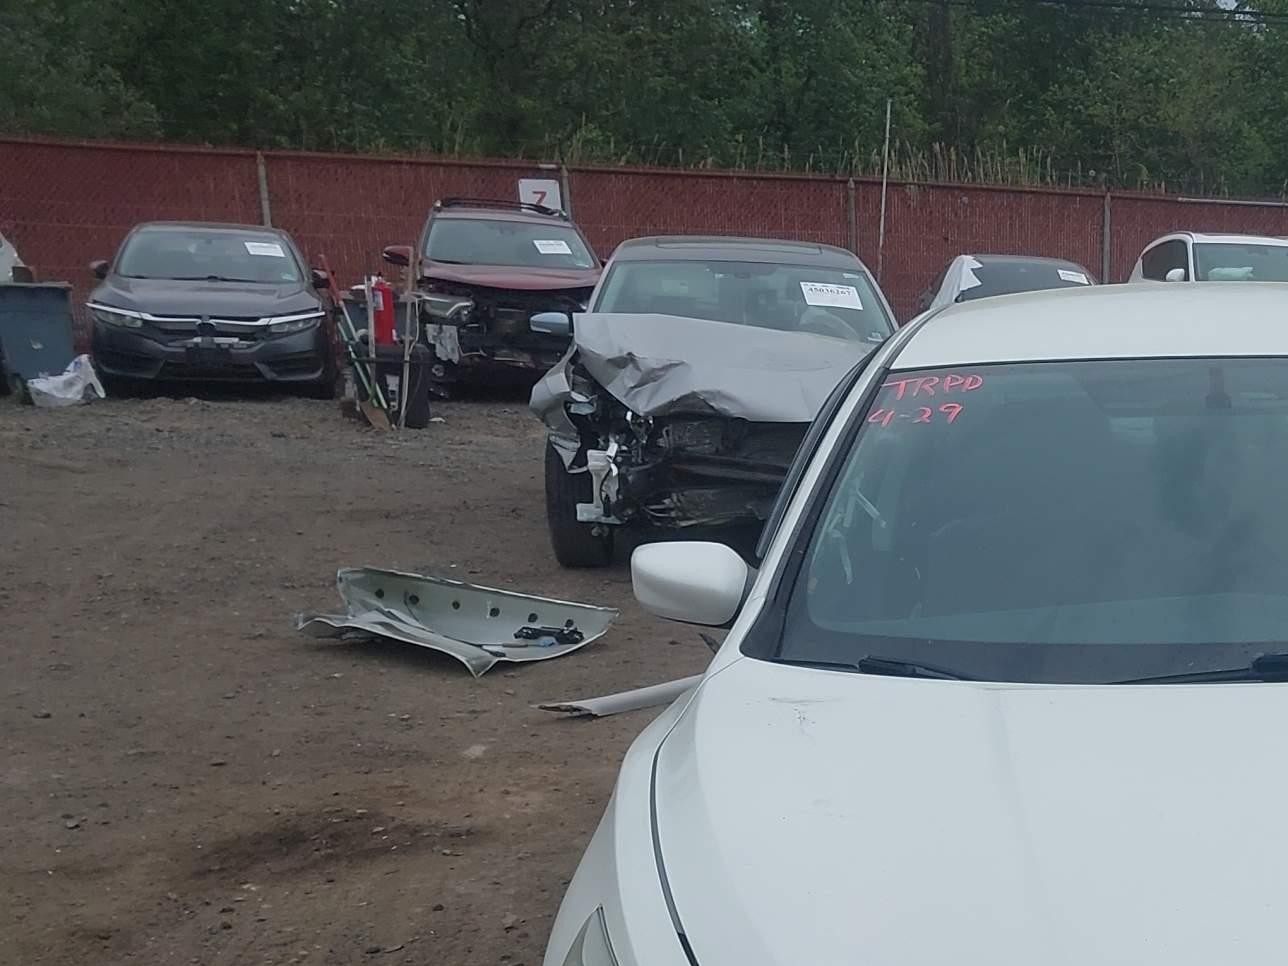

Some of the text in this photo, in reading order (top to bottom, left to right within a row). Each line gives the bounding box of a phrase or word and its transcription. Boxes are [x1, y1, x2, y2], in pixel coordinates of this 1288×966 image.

[532, 190, 548, 206] 7
[881, 374, 983, 400] TRPD
[868, 403, 964, 427] 4-29
